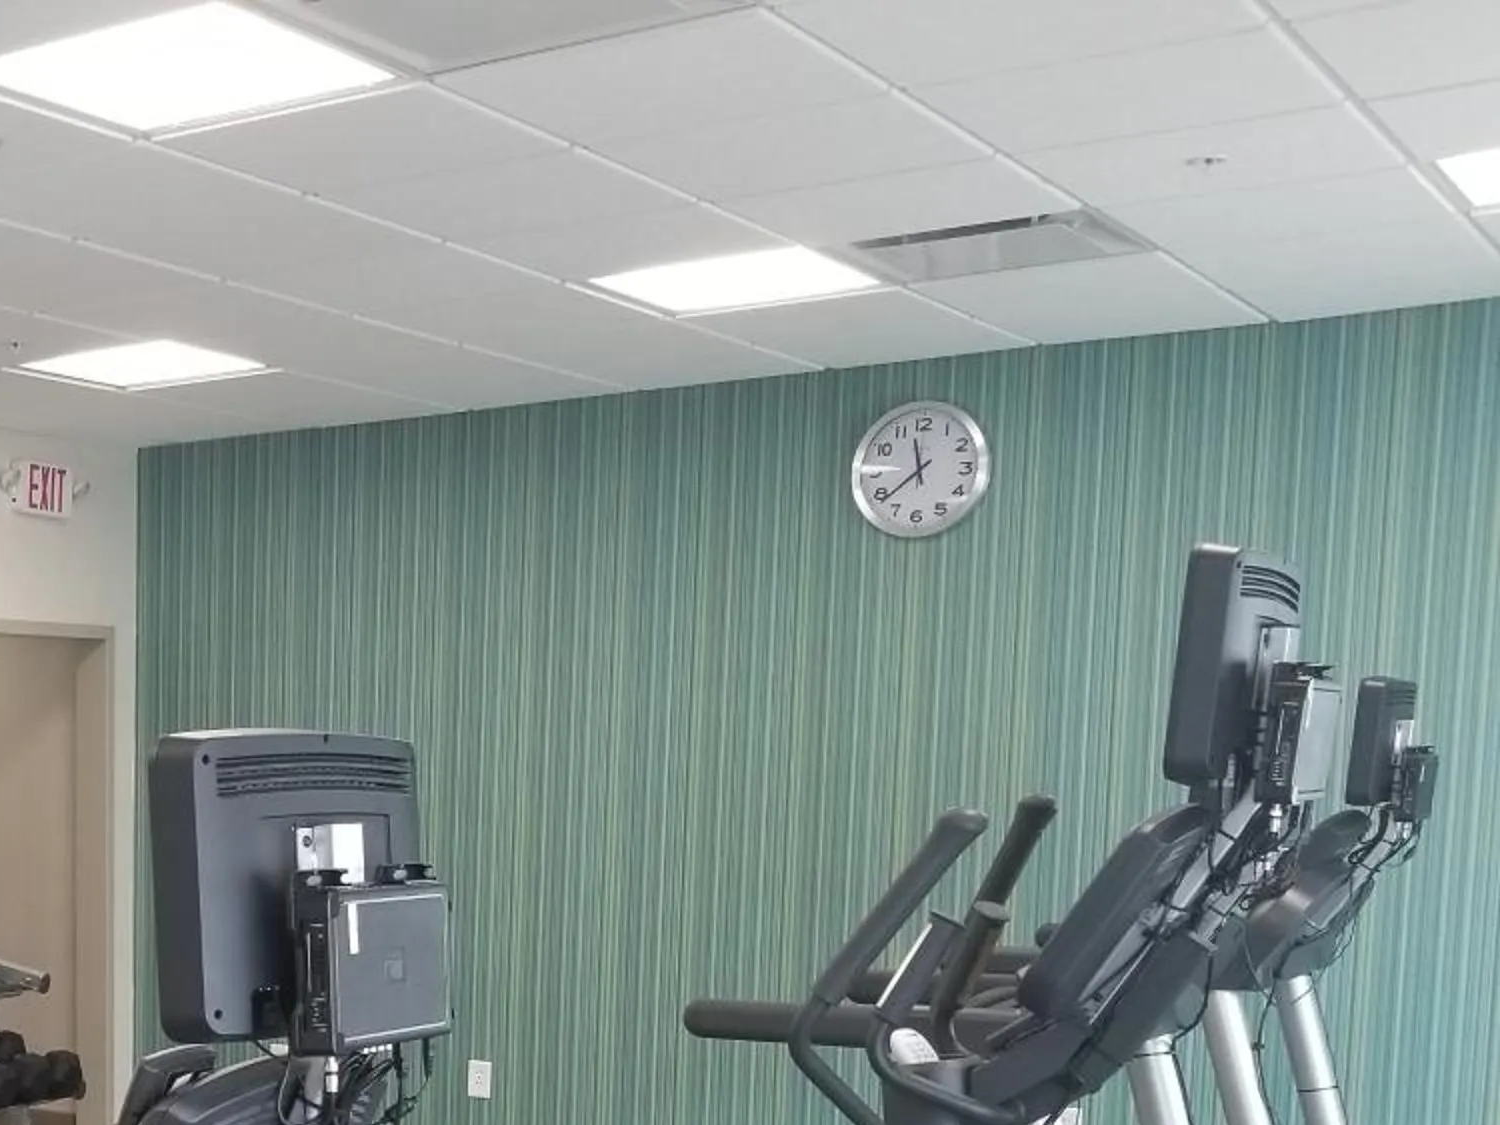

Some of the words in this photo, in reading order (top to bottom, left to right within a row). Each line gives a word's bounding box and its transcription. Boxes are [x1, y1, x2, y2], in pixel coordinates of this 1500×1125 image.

[915, 417, 933, 431] 12
[895, 425, 907, 438] 11
[877, 443, 893, 456] 10
[956, 438, 969, 452] 2
[958, 461, 973, 475] 3
[28, 463, 67, 513] EXIT
[951, 484, 965, 497] 4
[891, 504, 901, 517] 7
[934, 503, 948, 516] 5
[909, 510, 923, 523] 6
